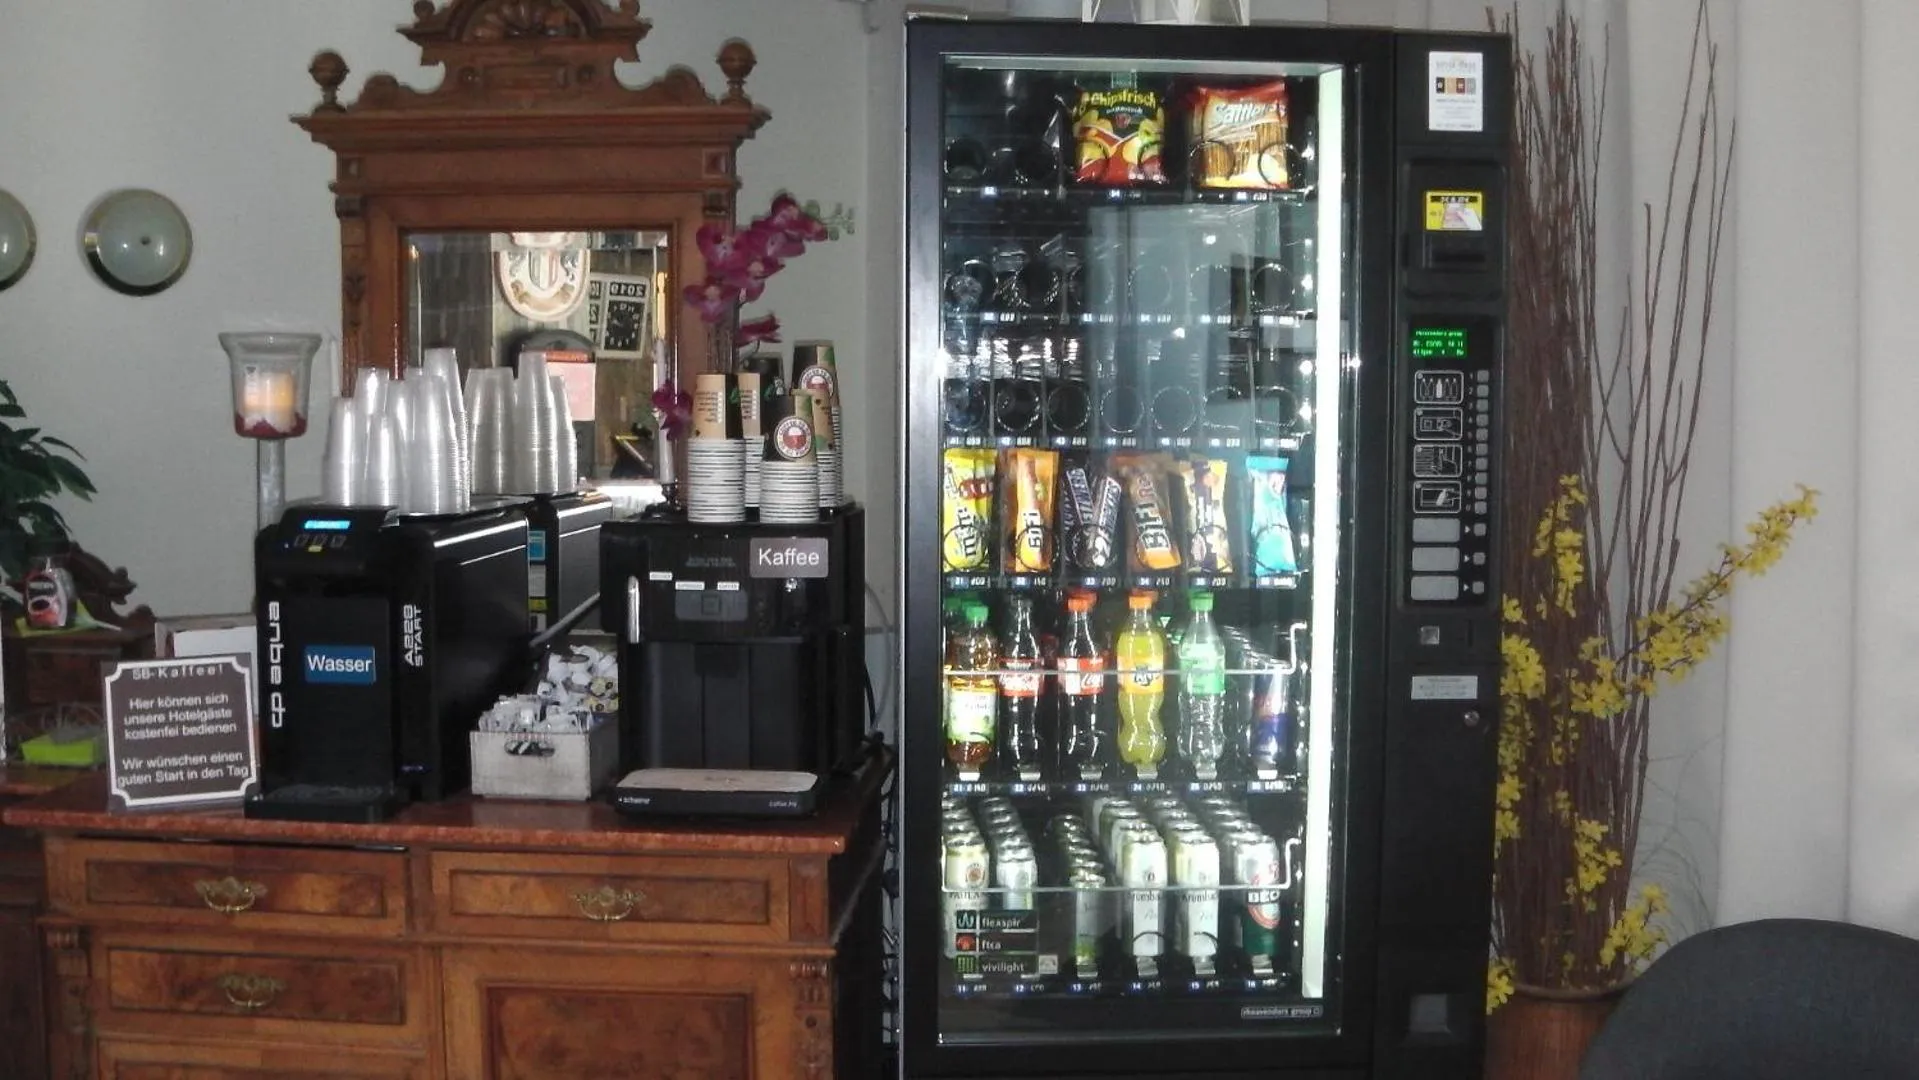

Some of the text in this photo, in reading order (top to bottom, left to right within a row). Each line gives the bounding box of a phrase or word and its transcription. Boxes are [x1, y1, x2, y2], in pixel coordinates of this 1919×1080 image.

[1091, 89, 1156, 108] Chipsfrisch
[758, 548, 820, 567] Kaffee
[414, 605, 424, 667] START
[307, 654, 373, 673] Wasser
[129, 692, 229, 710] Hier können sich
[124, 708, 233, 725] unsere Hotelgäste
[182, 722, 237, 736] bedienen
[122, 751, 243, 770] Wir wünschen einen
[117, 764, 249, 787] guten Start in den Tag
[982, 961, 1025, 973] vivilight
